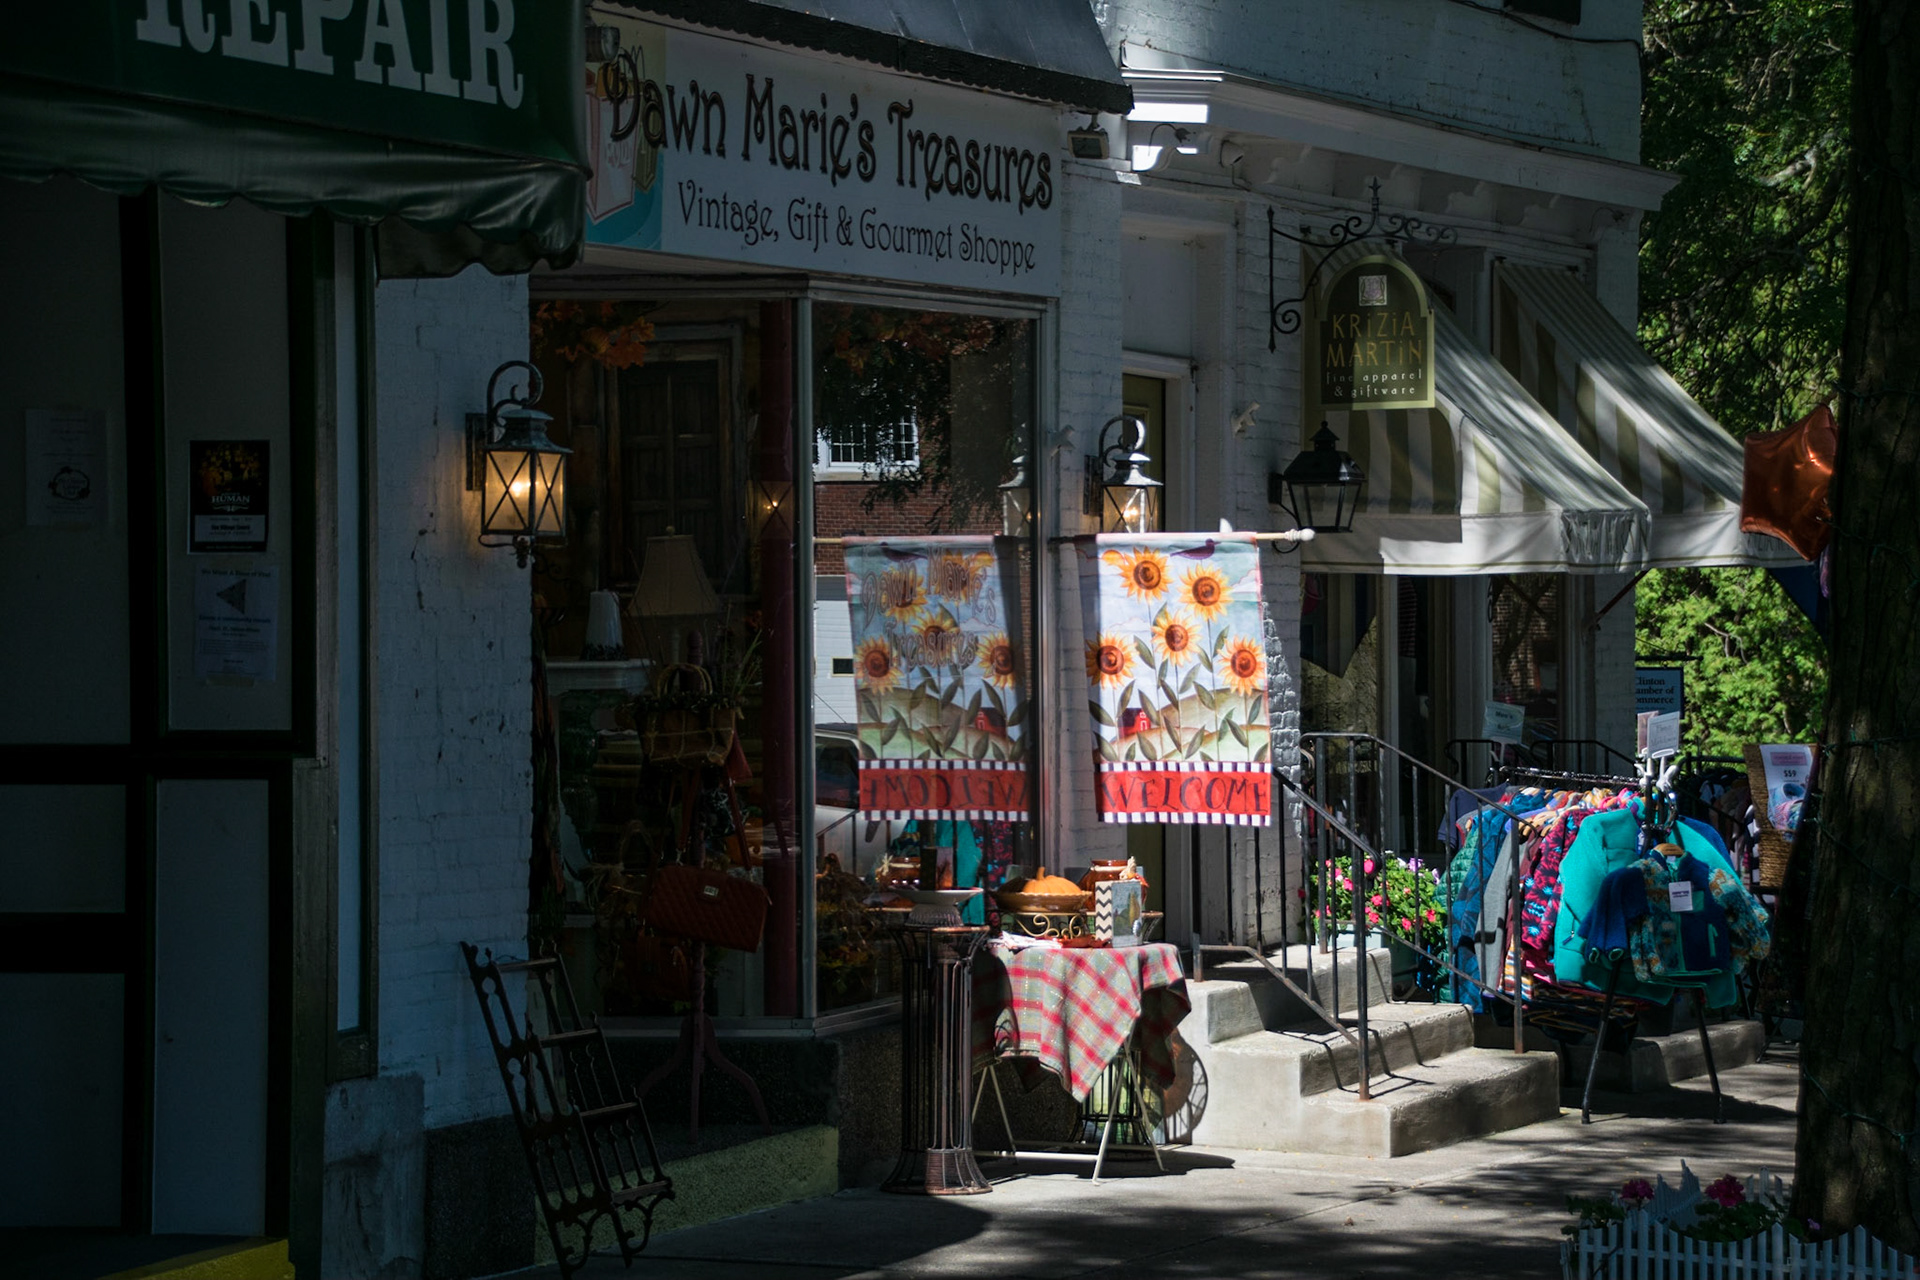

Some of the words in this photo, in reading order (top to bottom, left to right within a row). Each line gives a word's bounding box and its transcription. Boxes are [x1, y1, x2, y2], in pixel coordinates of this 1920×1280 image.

[603, 48, 726, 159] Dawn
[741, 73, 877, 188] Marie's
[887, 98, 1053, 215] Treasures
[678, 179, 779, 246] Vintage,
[787, 197, 829, 253] Gift
[836, 205, 853, 247] &
[859, 207, 953, 262] Gourmet
[959, 223, 1036, 276] Shoppe
[1326, 371, 1354, 384] fine
[1362, 369, 1422, 384] apparel
[1334, 386, 1344, 398] &
[1350, 385, 1416, 399] giftware
[1665, 685, 1675, 695] of
[1102, 775, 1270, 813] WELCOME
